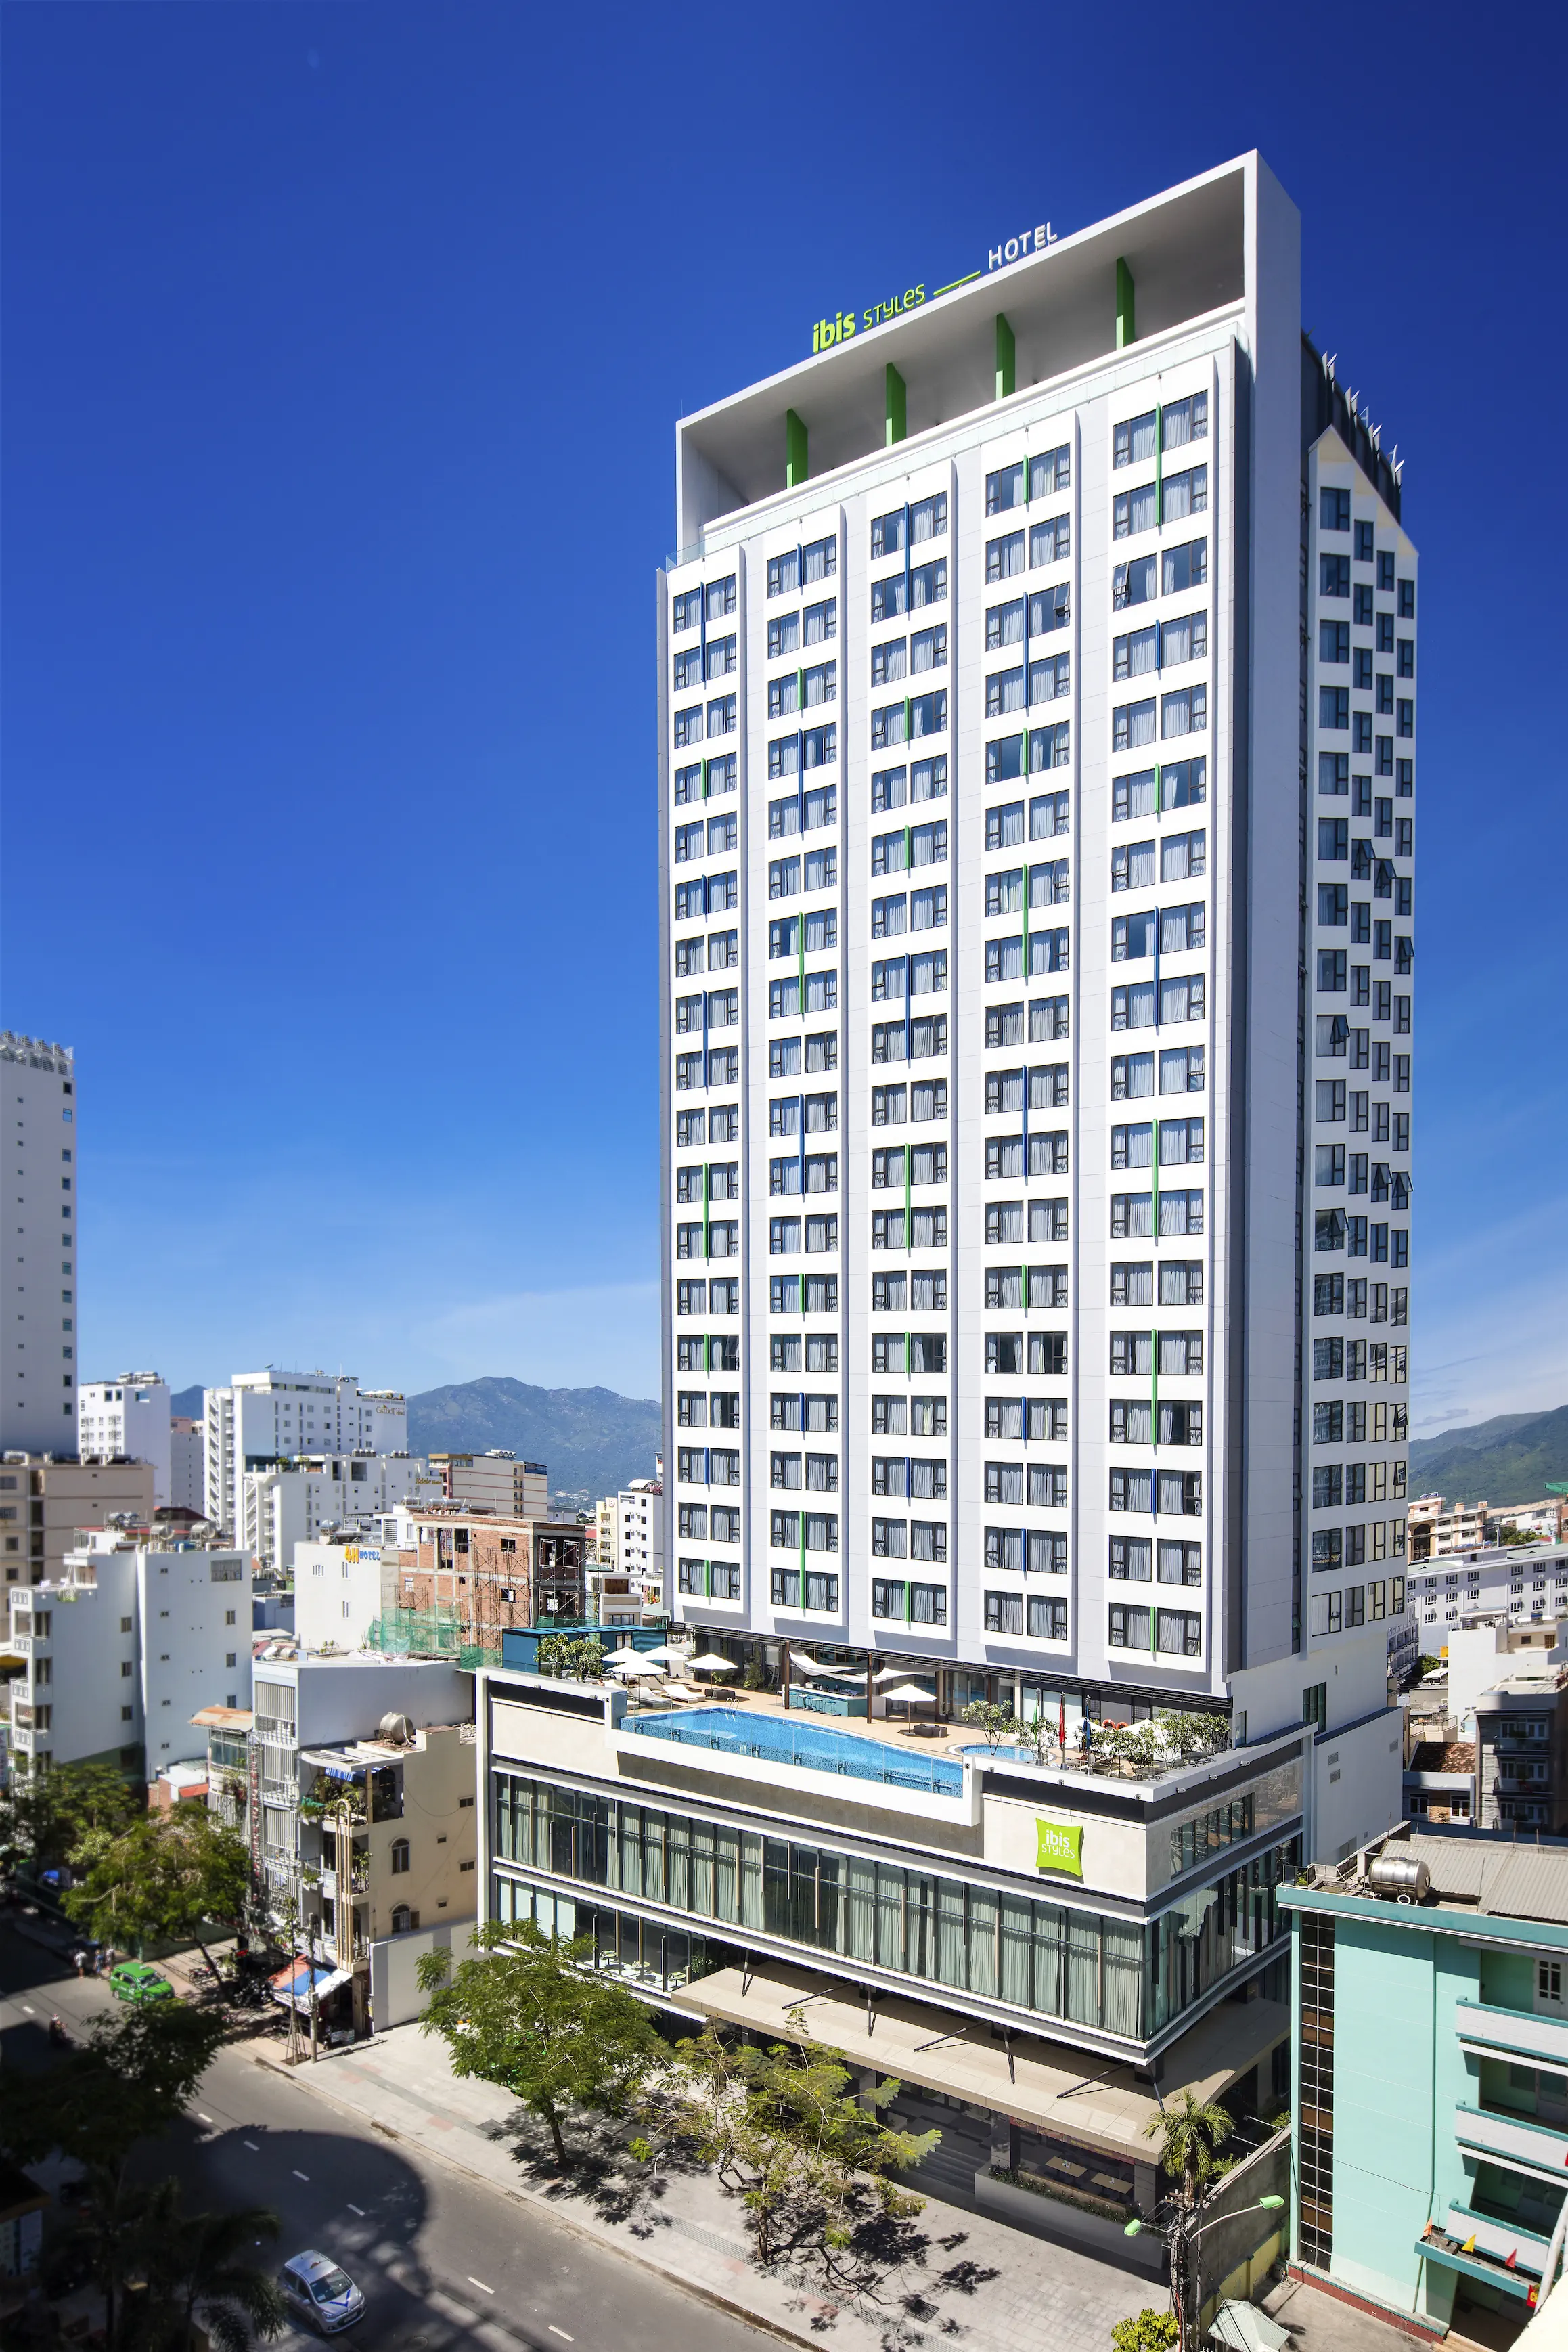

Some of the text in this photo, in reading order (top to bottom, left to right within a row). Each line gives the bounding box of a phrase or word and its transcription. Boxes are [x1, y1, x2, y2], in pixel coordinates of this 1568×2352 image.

[813, 312, 855, 353] ibis
[989, 222, 1057, 270] HOTEL
[345, 1545, 380, 1564] 4H HOTEL
[1046, 1830, 1070, 1848] ibis
